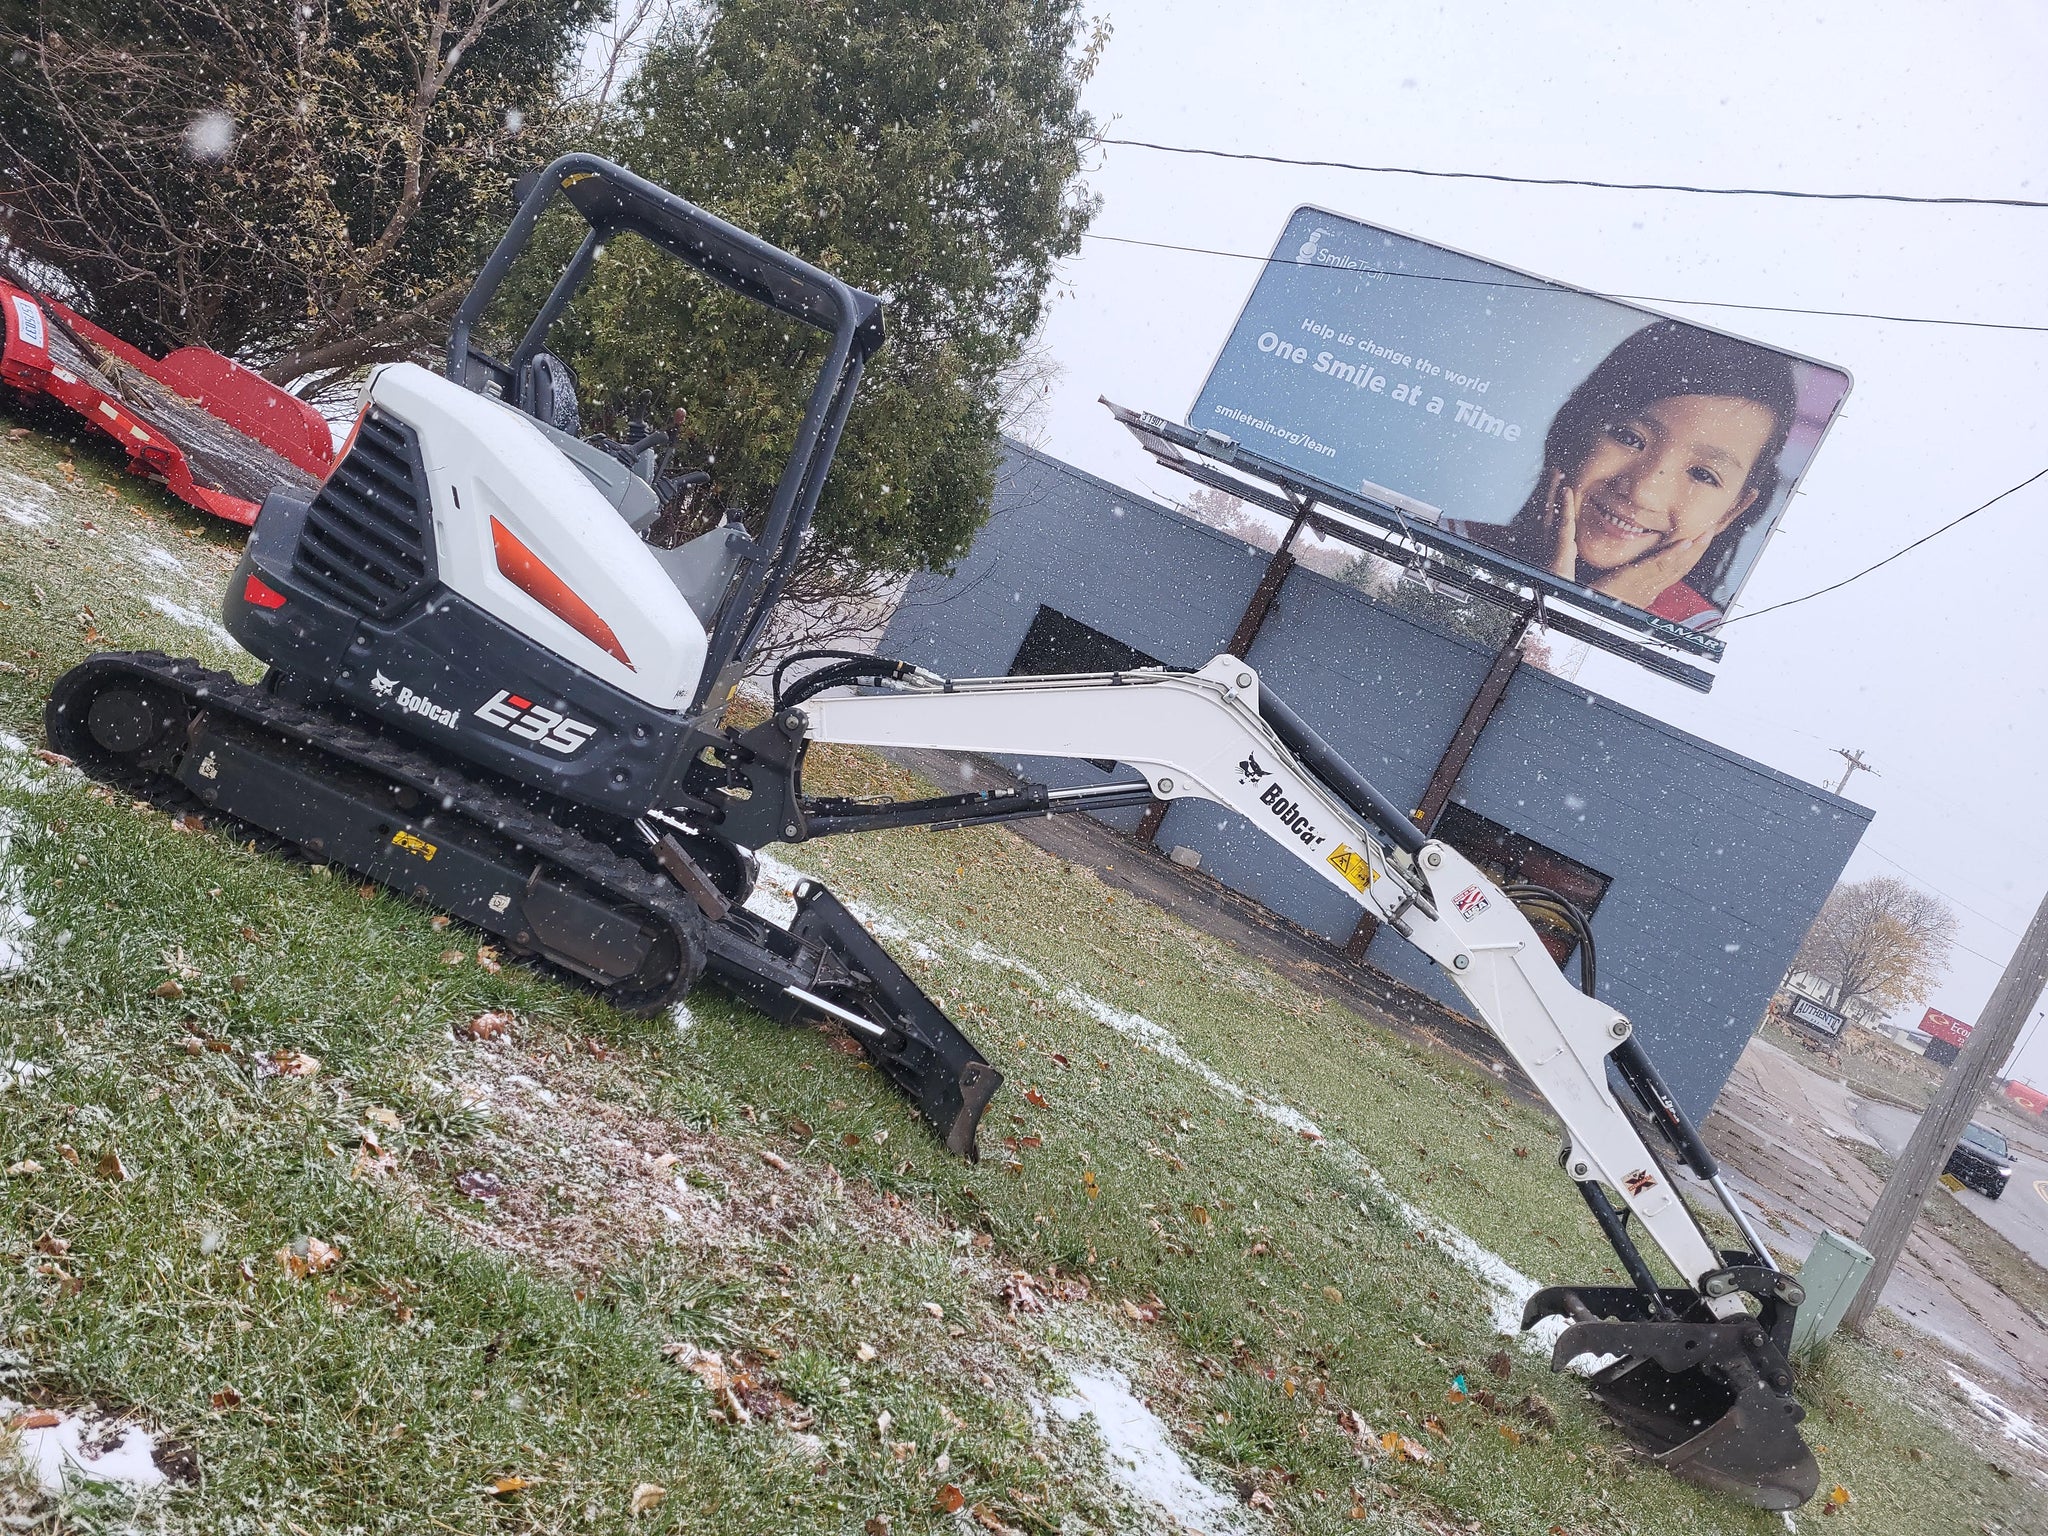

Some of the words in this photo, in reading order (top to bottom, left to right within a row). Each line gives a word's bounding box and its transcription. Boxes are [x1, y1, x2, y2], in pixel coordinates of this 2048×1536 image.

[1301, 318, 1335, 340] Help
[1338, 331, 1355, 346] us
[1358, 337, 1412, 368] change
[1415, 358, 1441, 377] the
[1444, 369, 1491, 394] world
[1257, 331, 1308, 364] One
[1313, 352, 1386, 393] Smile
[1391, 383, 1423, 406] at
[1426, 396, 1445, 415] a
[1454, 399, 1522, 442] Time
[1214, 404, 1337, 458] smiletrain.org/learn
[1650, 617, 1720, 649] LAMAR
[396, 686, 461, 729] Bobcat
[473, 689, 598, 754] E35
[1463, 899, 1489, 919] USA
